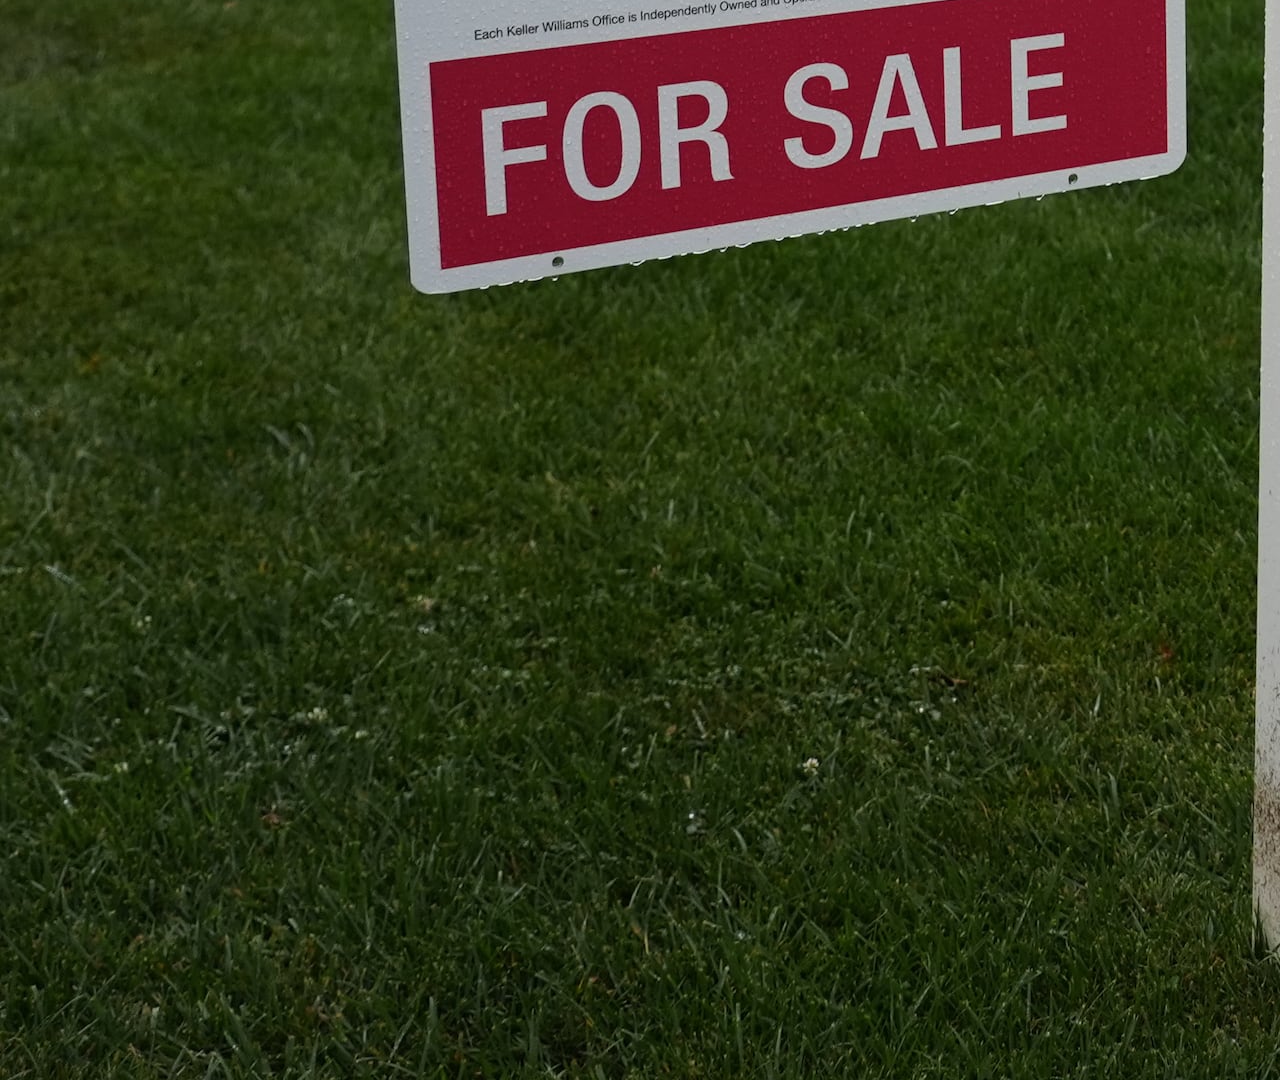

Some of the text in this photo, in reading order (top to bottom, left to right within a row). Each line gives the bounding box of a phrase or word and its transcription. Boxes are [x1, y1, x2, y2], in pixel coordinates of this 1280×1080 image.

[474, 27, 503, 40] Each
[506, 24, 540, 37] Keller
[541, 19, 589, 33] Williams
[592, 14, 625, 27] Office
[628, 11, 637, 22] is
[640, 3, 717, 21] Independently
[480, 31, 1069, 218] FOR SALE
